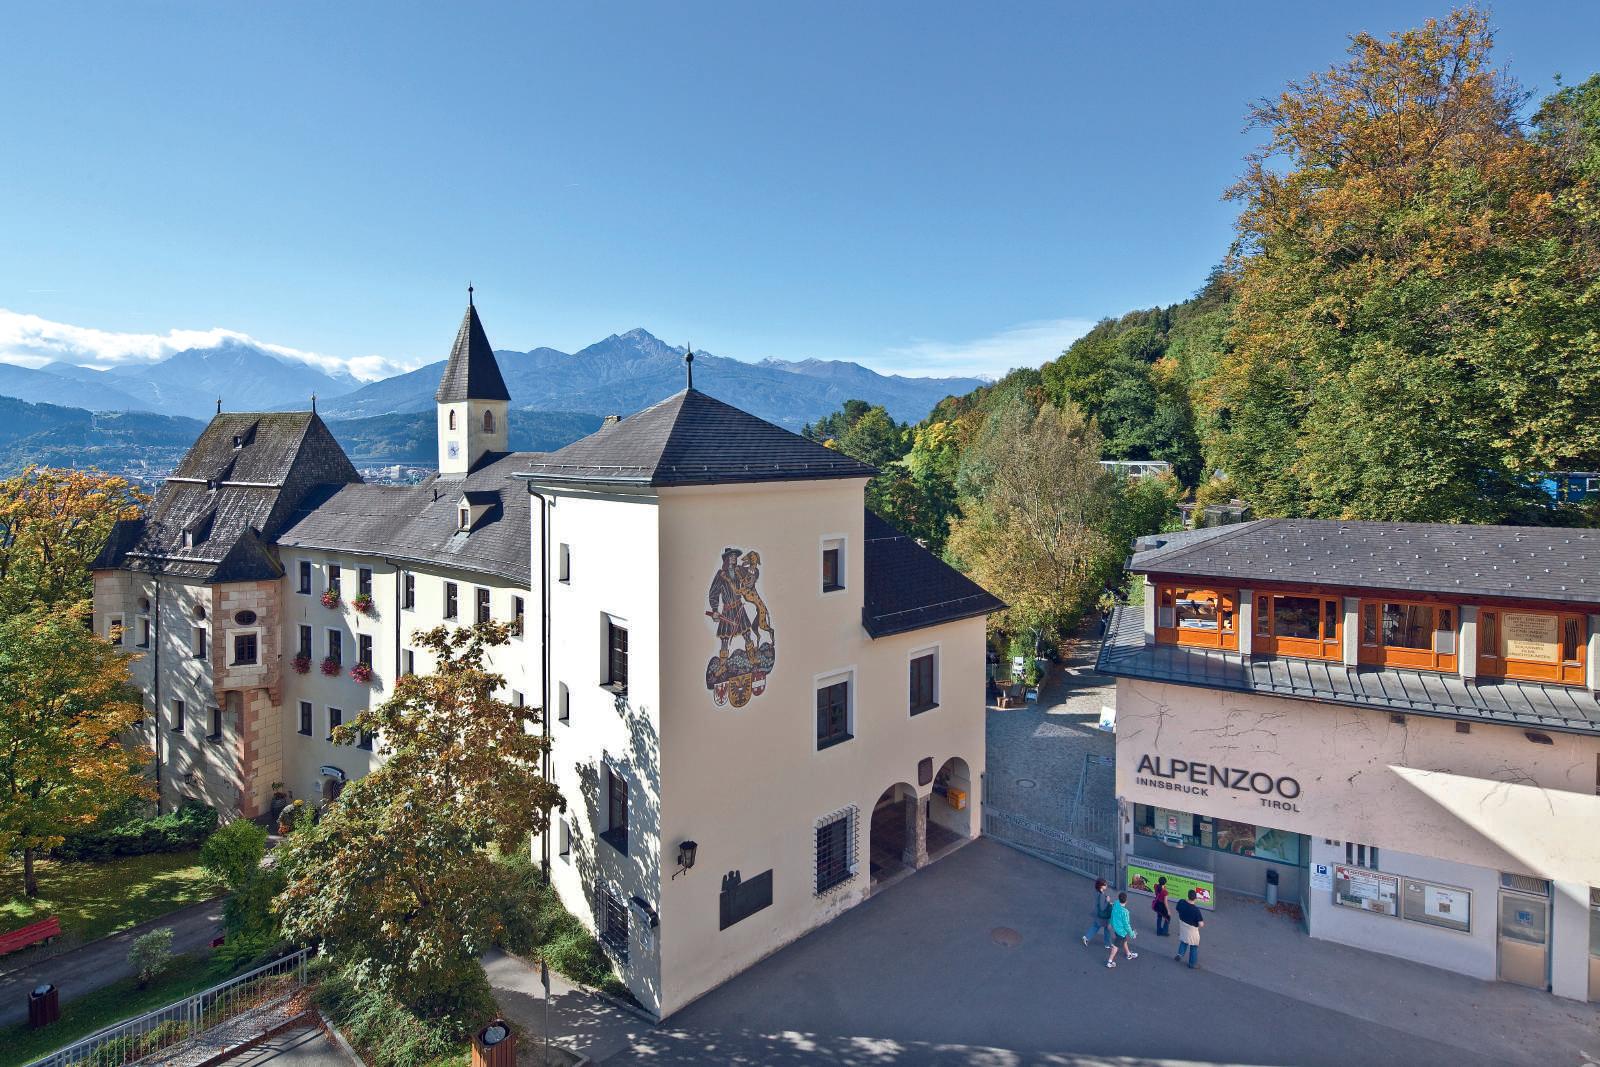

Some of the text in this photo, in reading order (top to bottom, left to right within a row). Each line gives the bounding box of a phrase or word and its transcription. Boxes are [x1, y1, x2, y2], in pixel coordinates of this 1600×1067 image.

[1136, 776, 1209, 797] INNSBRUCK
[1137, 753, 1301, 799] ALPENZOO
[1260, 798, 1301, 813] TIROL
